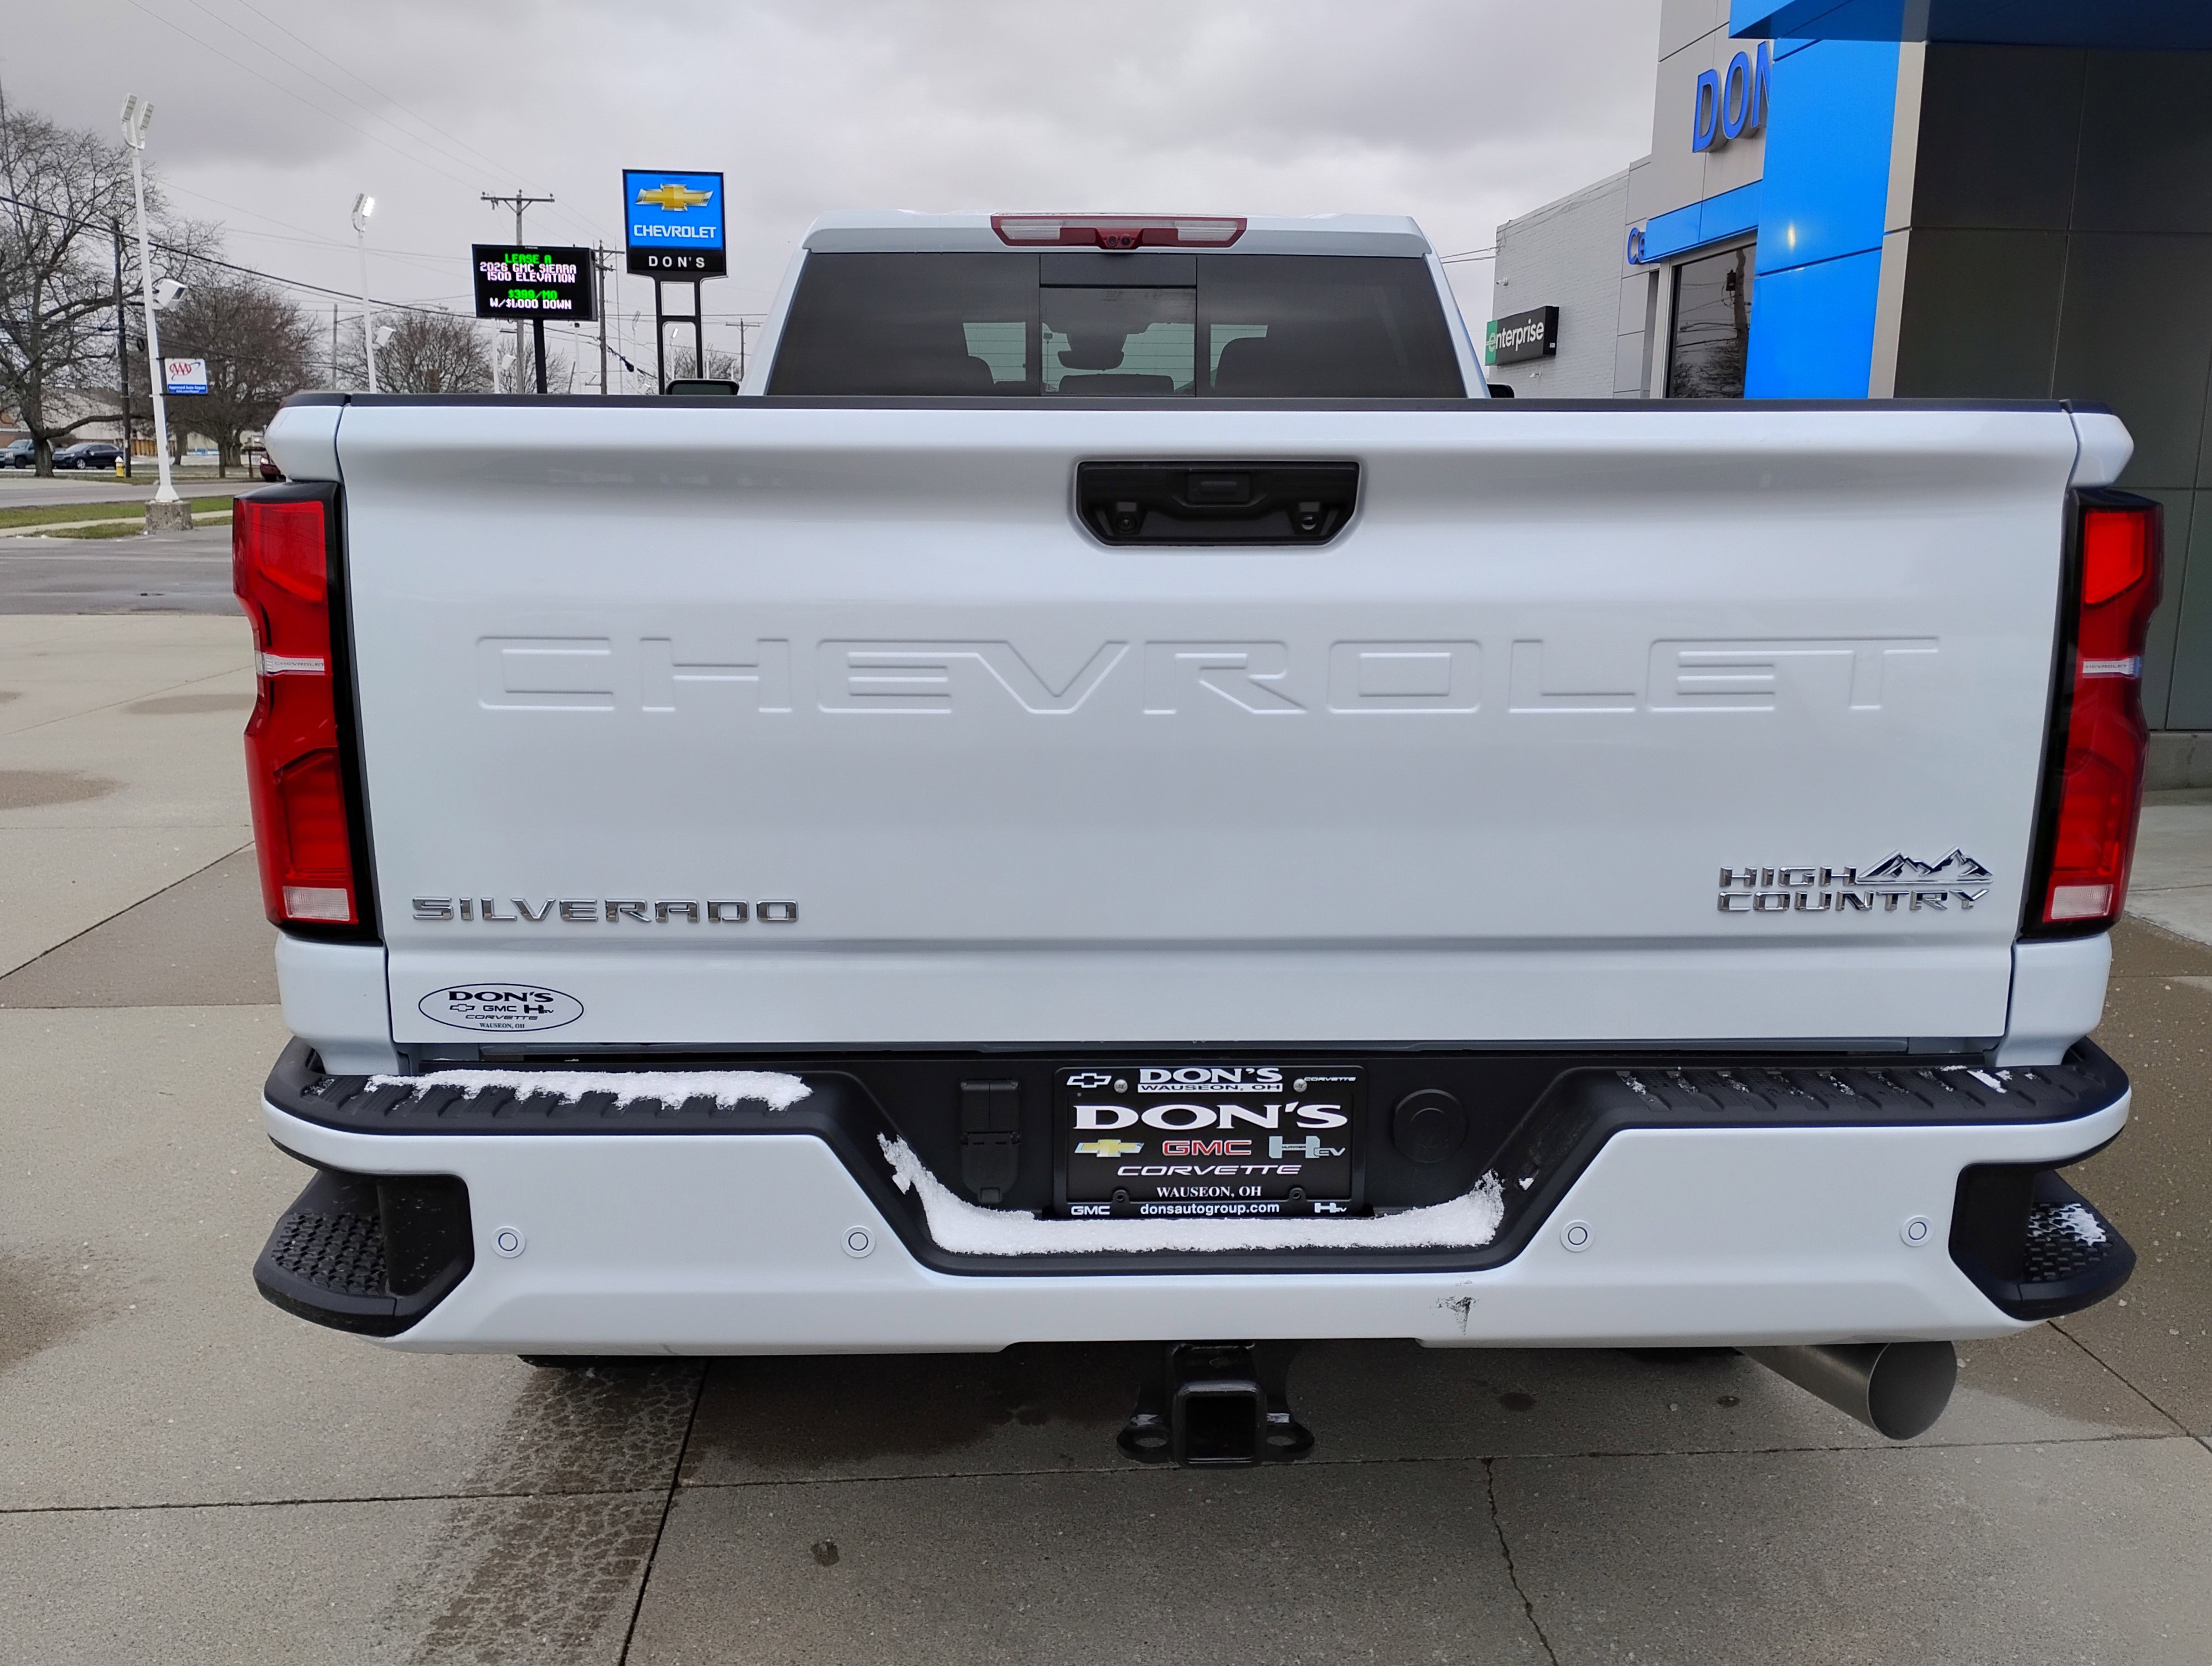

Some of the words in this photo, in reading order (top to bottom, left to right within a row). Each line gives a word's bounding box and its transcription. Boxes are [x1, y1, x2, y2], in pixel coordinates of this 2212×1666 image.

[633, 224, 717, 238] CHEVROLET
[504, 253, 540, 264] LEASE
[544, 254, 552, 264] A
[648, 256, 705, 269] DON'S
[479, 261, 508, 272] 2026
[512, 263, 534, 273] GMC
[539, 264, 577, 274] SIERRA
[487, 271, 511, 281] 1500
[515, 272, 576, 283] ELEVATION
[508, 289, 558, 300] $399/MO
[542, 300, 572, 310] DOWN
[1486, 318, 1544, 352] enterprise
[169, 362, 192, 375] AAA
[477, 636, 1940, 714] CHEVROLET
[1719, 865, 1857, 887] HIGH
[1717, 889, 1989, 912] COUNTRY
[412, 896, 800, 923] SILVERADO
[448, 991, 554, 1003] DON'S
[483, 1004, 517, 1013] GMC
[1139, 1068, 1283, 1084] DON'S
[1073, 1101, 1348, 1131] DON'S
[1162, 1139, 1252, 1156] GMC
[1117, 1164, 1302, 1176] CORVETTE
[1156, 1186, 1235, 1198] WAUSEON,
[1239, 1186, 1262, 1196] OH
[1071, 1205, 1110, 1215] GMC
[1140, 1203, 1280, 1215] donsautogroup.com
